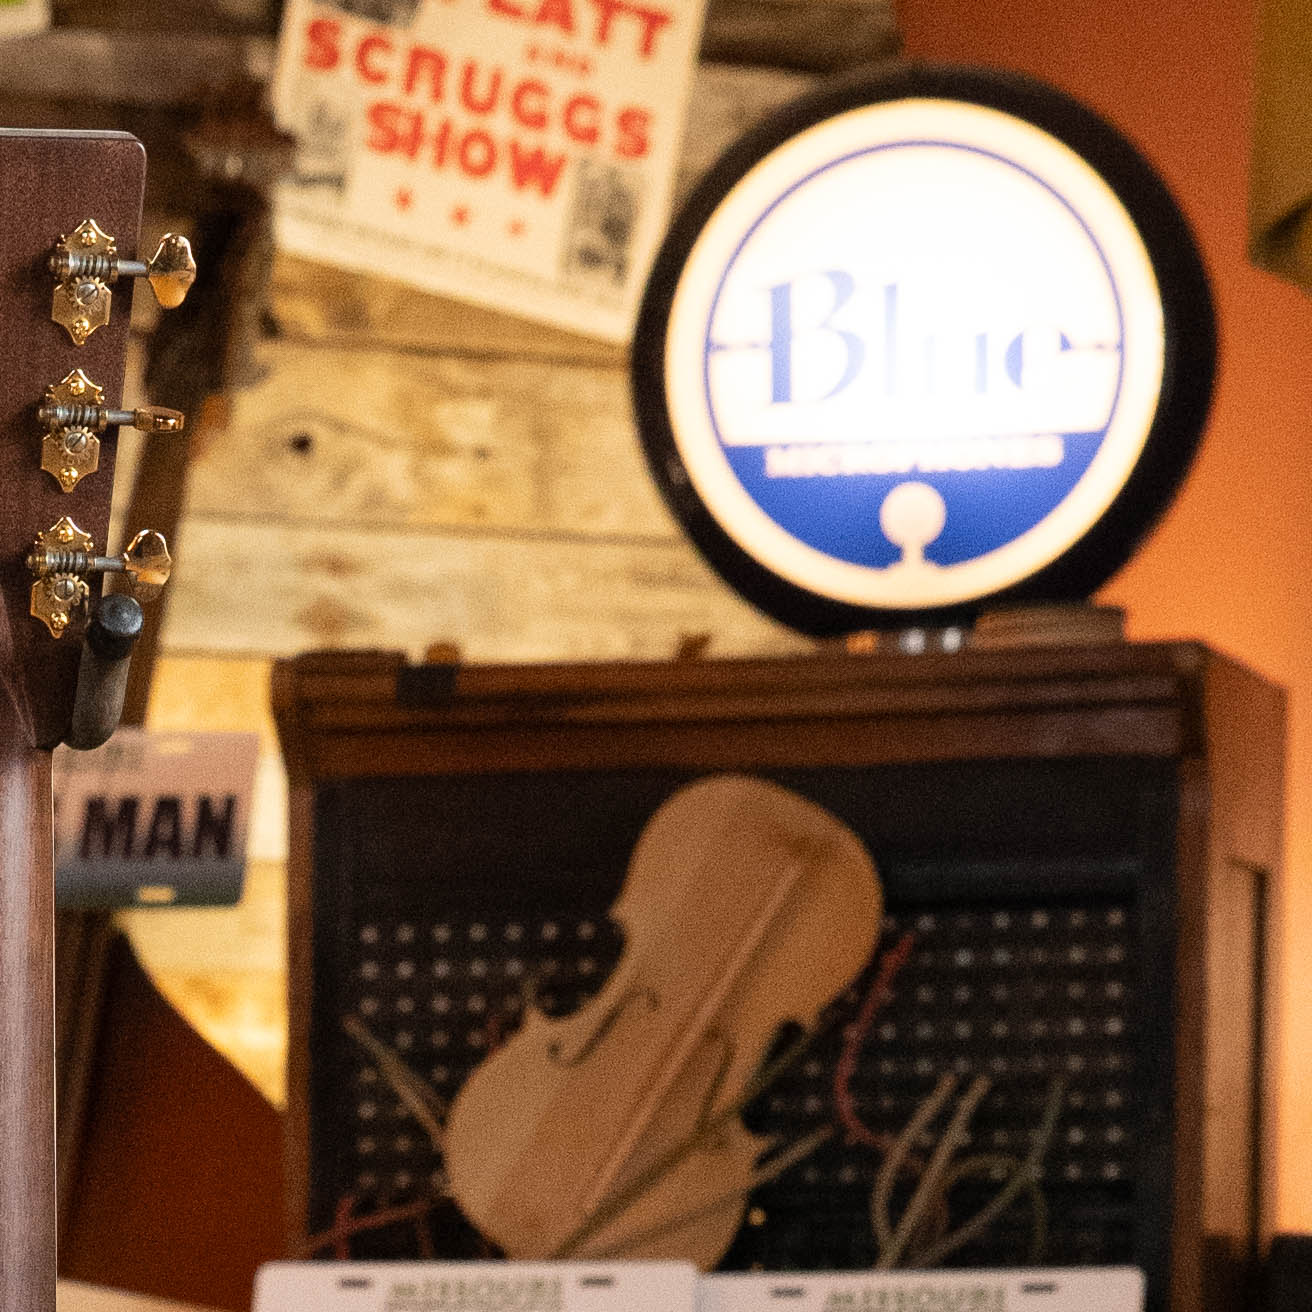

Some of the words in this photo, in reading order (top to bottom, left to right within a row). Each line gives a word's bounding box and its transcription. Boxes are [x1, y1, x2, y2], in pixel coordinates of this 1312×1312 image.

[304, 18, 654, 159] SCRUGGS
[365, 101, 569, 197] SHOW
[78, 794, 237, 861] MAN
